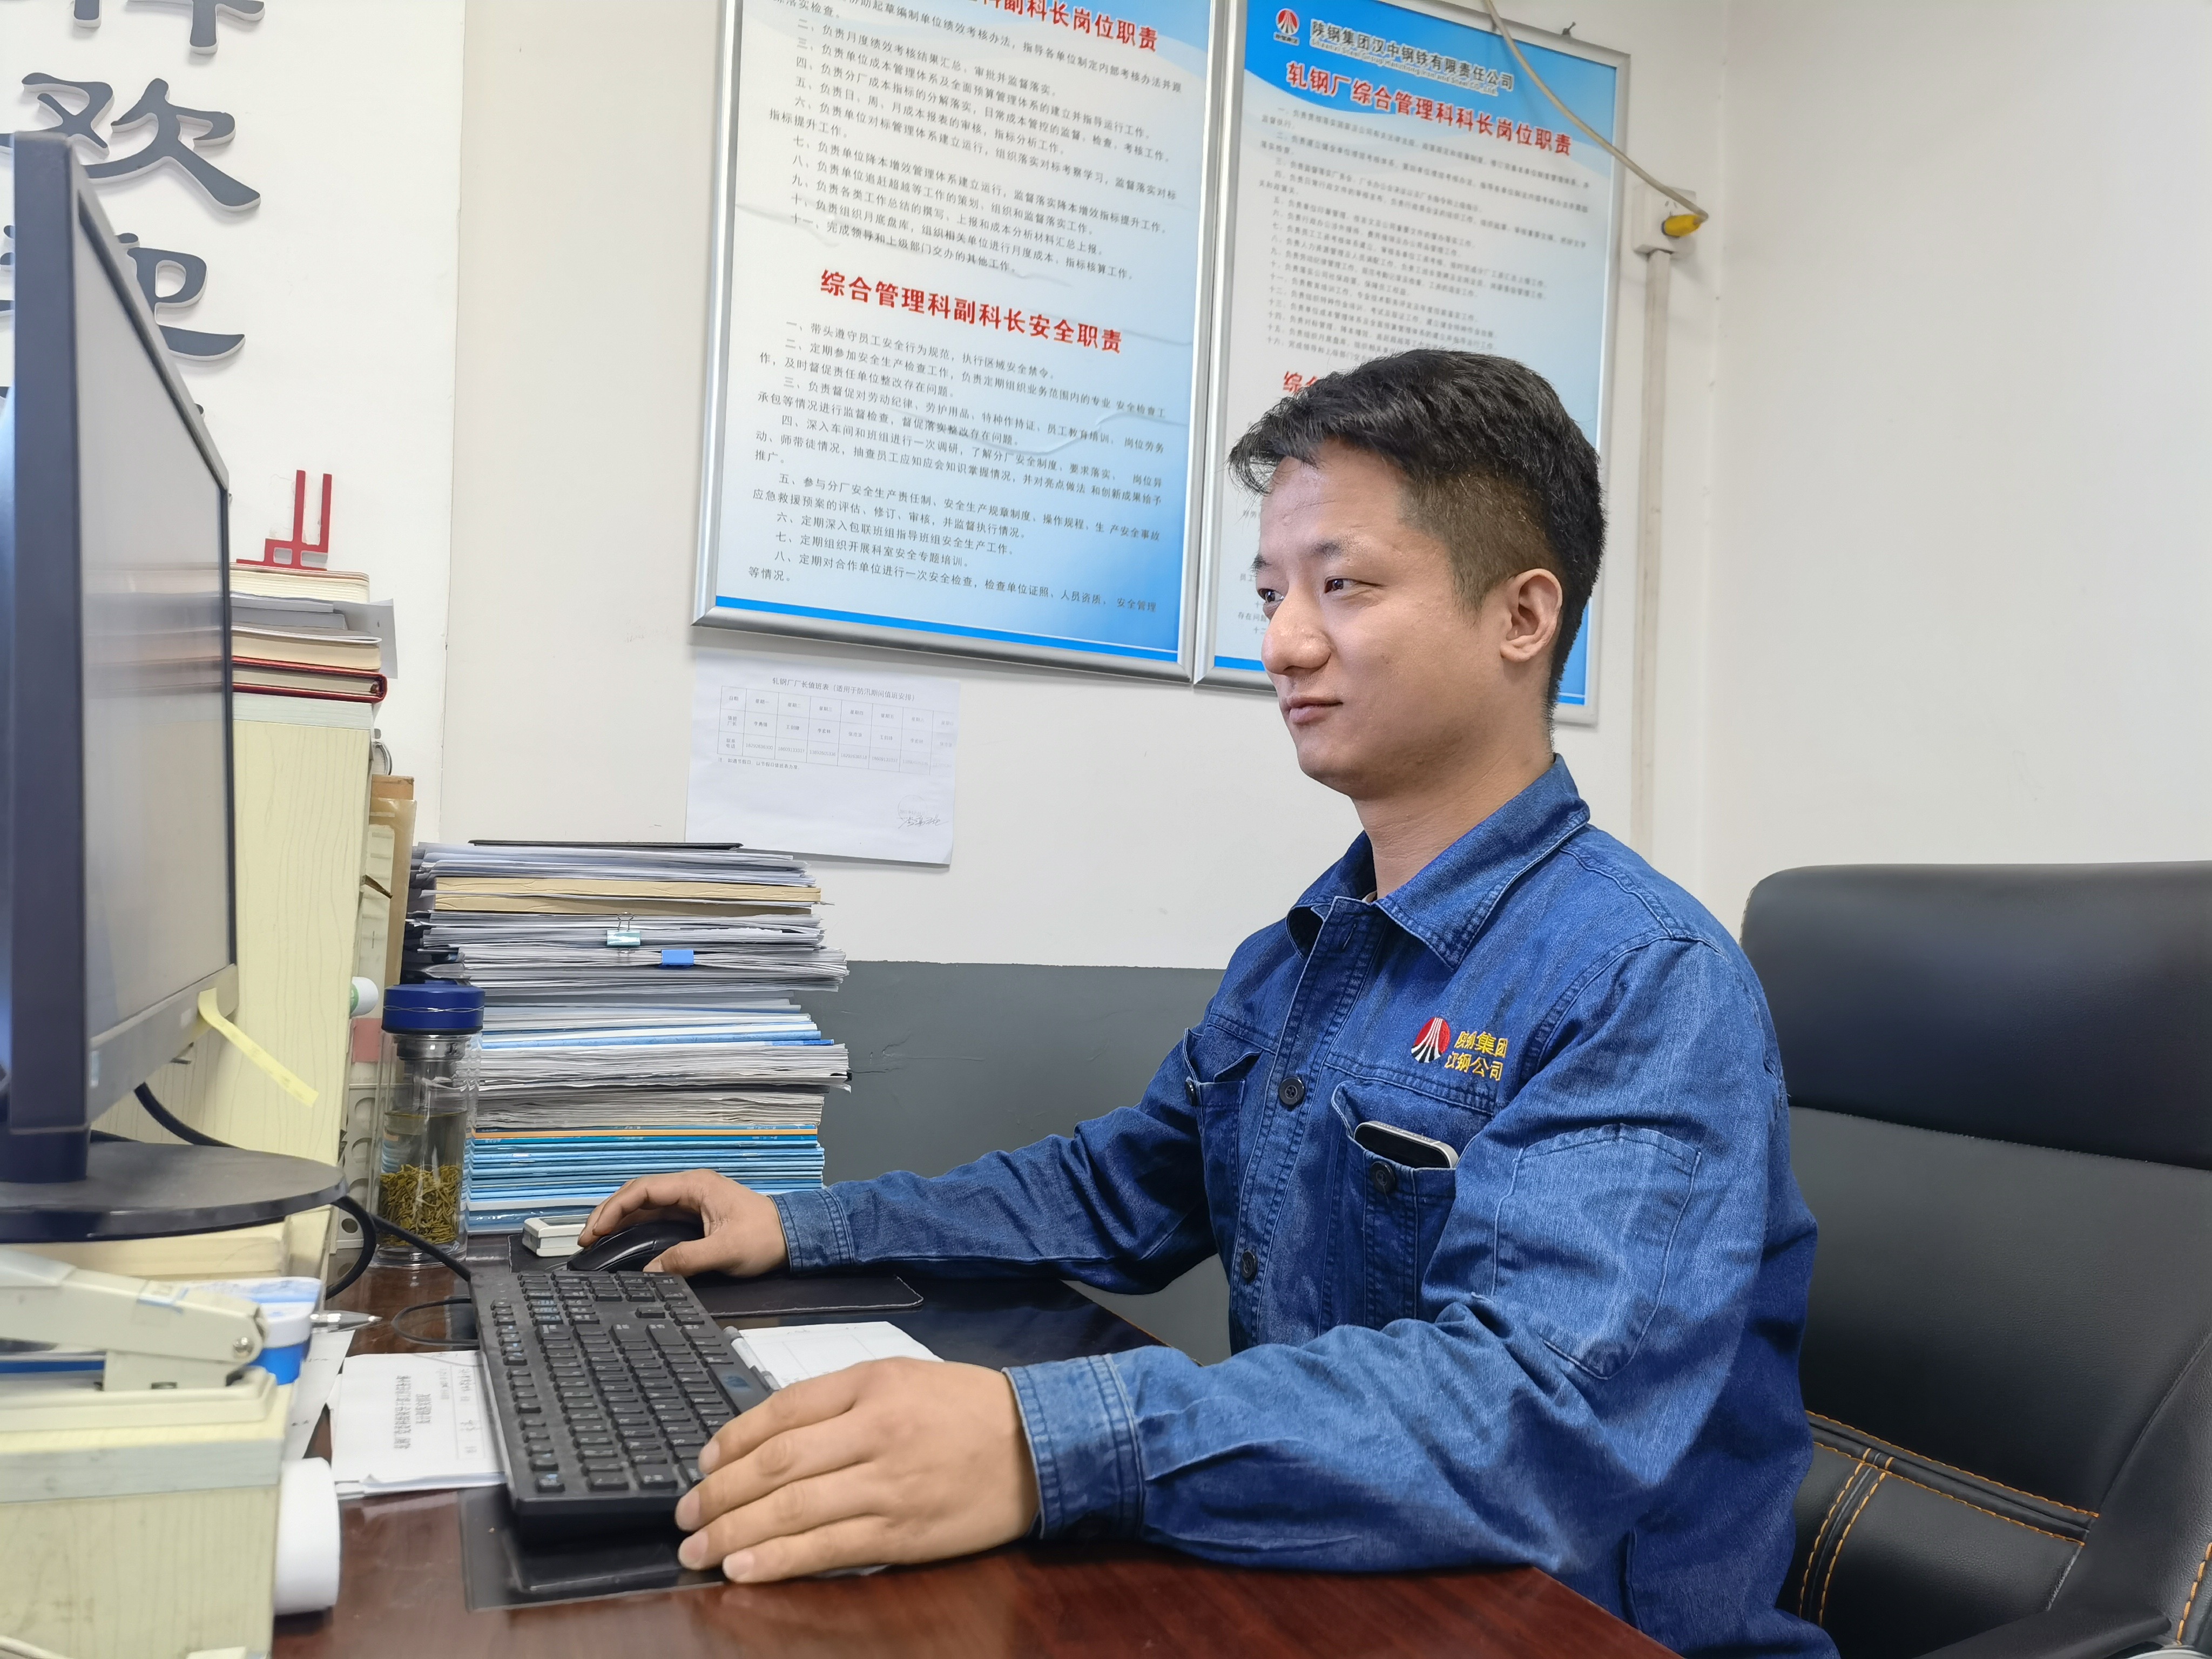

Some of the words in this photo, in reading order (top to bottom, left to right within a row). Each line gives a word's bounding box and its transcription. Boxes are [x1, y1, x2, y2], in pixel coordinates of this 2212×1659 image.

[1312, 19, 1513, 90] 陕钢集团汉中钢铁有限责任公司
[770, 107, 847, 138] 指标提升工作。
[1287, 62, 1572, 156] 轧钢厂综合管理科科长岗位职责
[820, 269, 1122, 355] 综合管理科副科长安全职责
[1283, 371, 1318, 395] 综
[754, 449, 786, 464] 推广。
[748, 565, 792, 582] 等情况。
